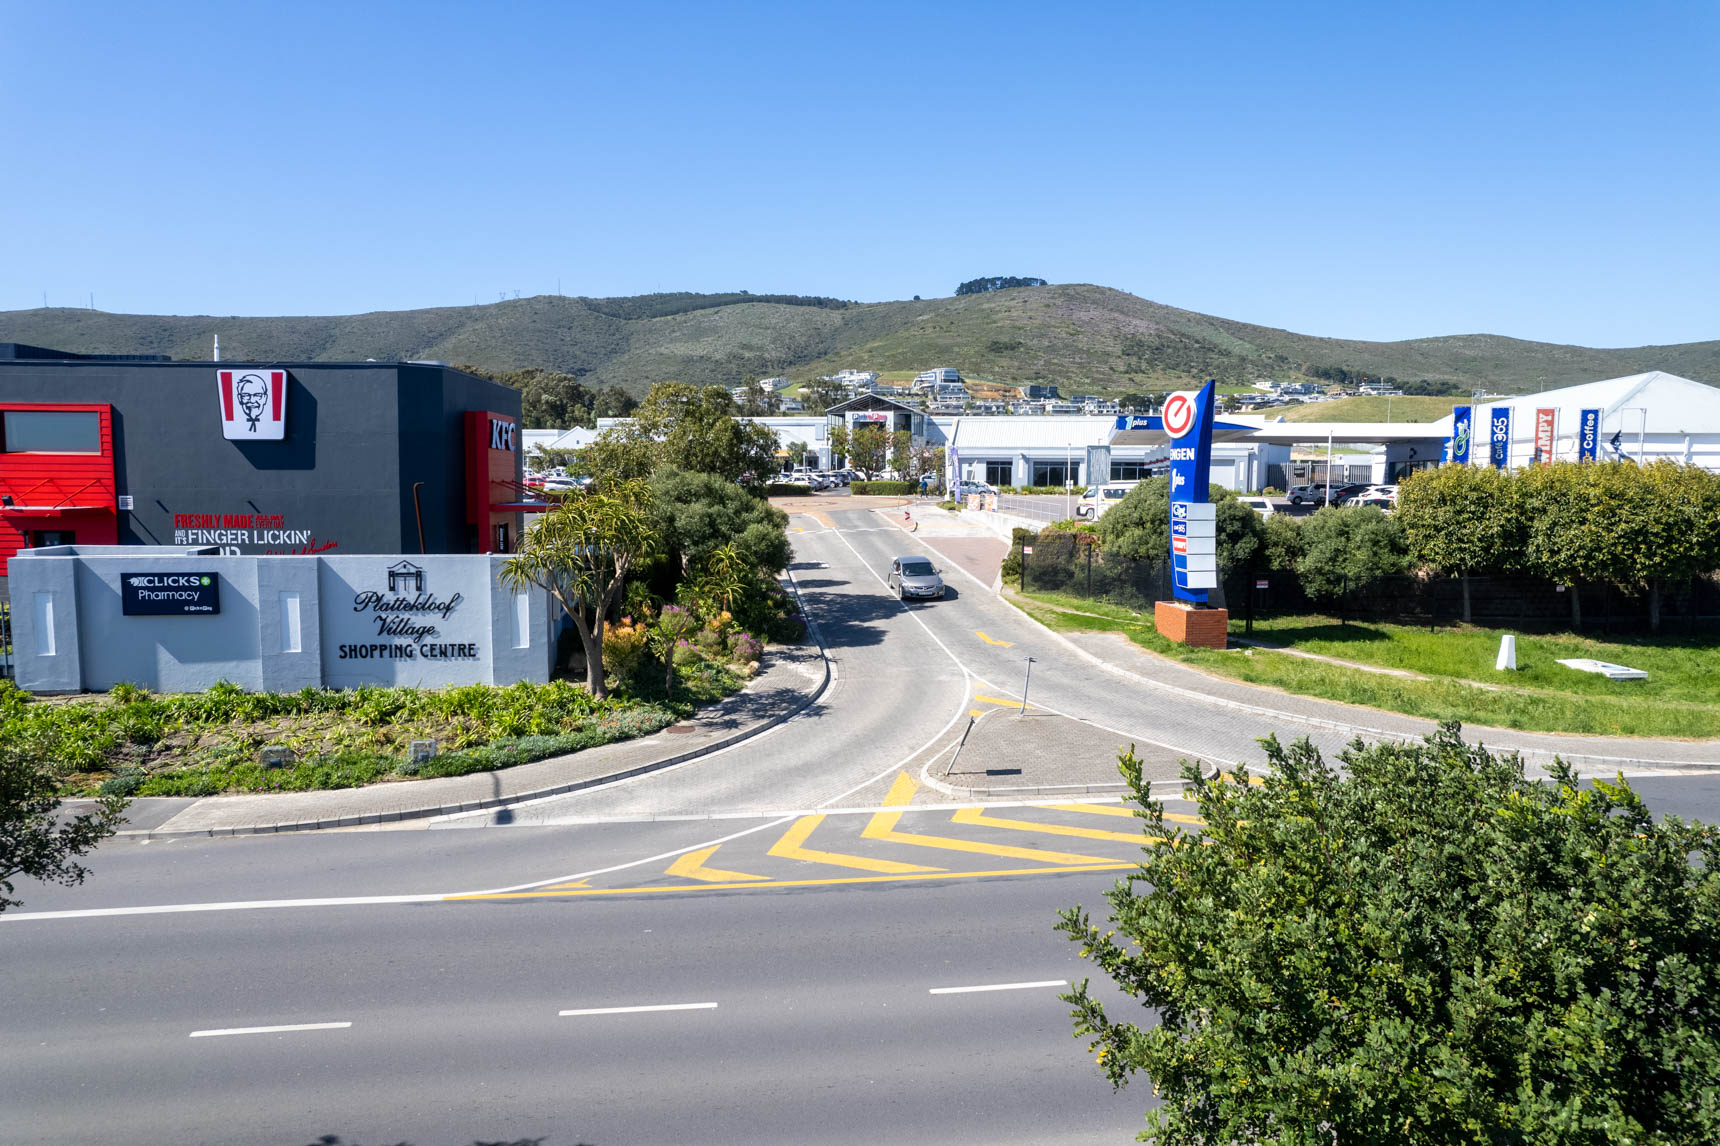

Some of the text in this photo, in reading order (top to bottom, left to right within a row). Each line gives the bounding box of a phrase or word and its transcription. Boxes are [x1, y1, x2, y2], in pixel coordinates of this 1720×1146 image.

[491, 419, 516, 451] KFC
[1493, 417, 1507, 459] Café 365
[1583, 413, 1595, 449] Coffee
[174, 513, 253, 529] FRESHLY MADE
[255, 520, 273, 528] EVERY
[174, 537, 187, 545] IT'S
[188, 529, 311, 545] FINGER LICKIN'
[144, 576, 200, 587] CLICKS
[138, 589, 200, 602] Pharmacy
[353, 591, 461, 619] Plattekloof
[373, 615, 436, 644] Village
[339, 643, 477, 659] SHOPPING CENTRE
